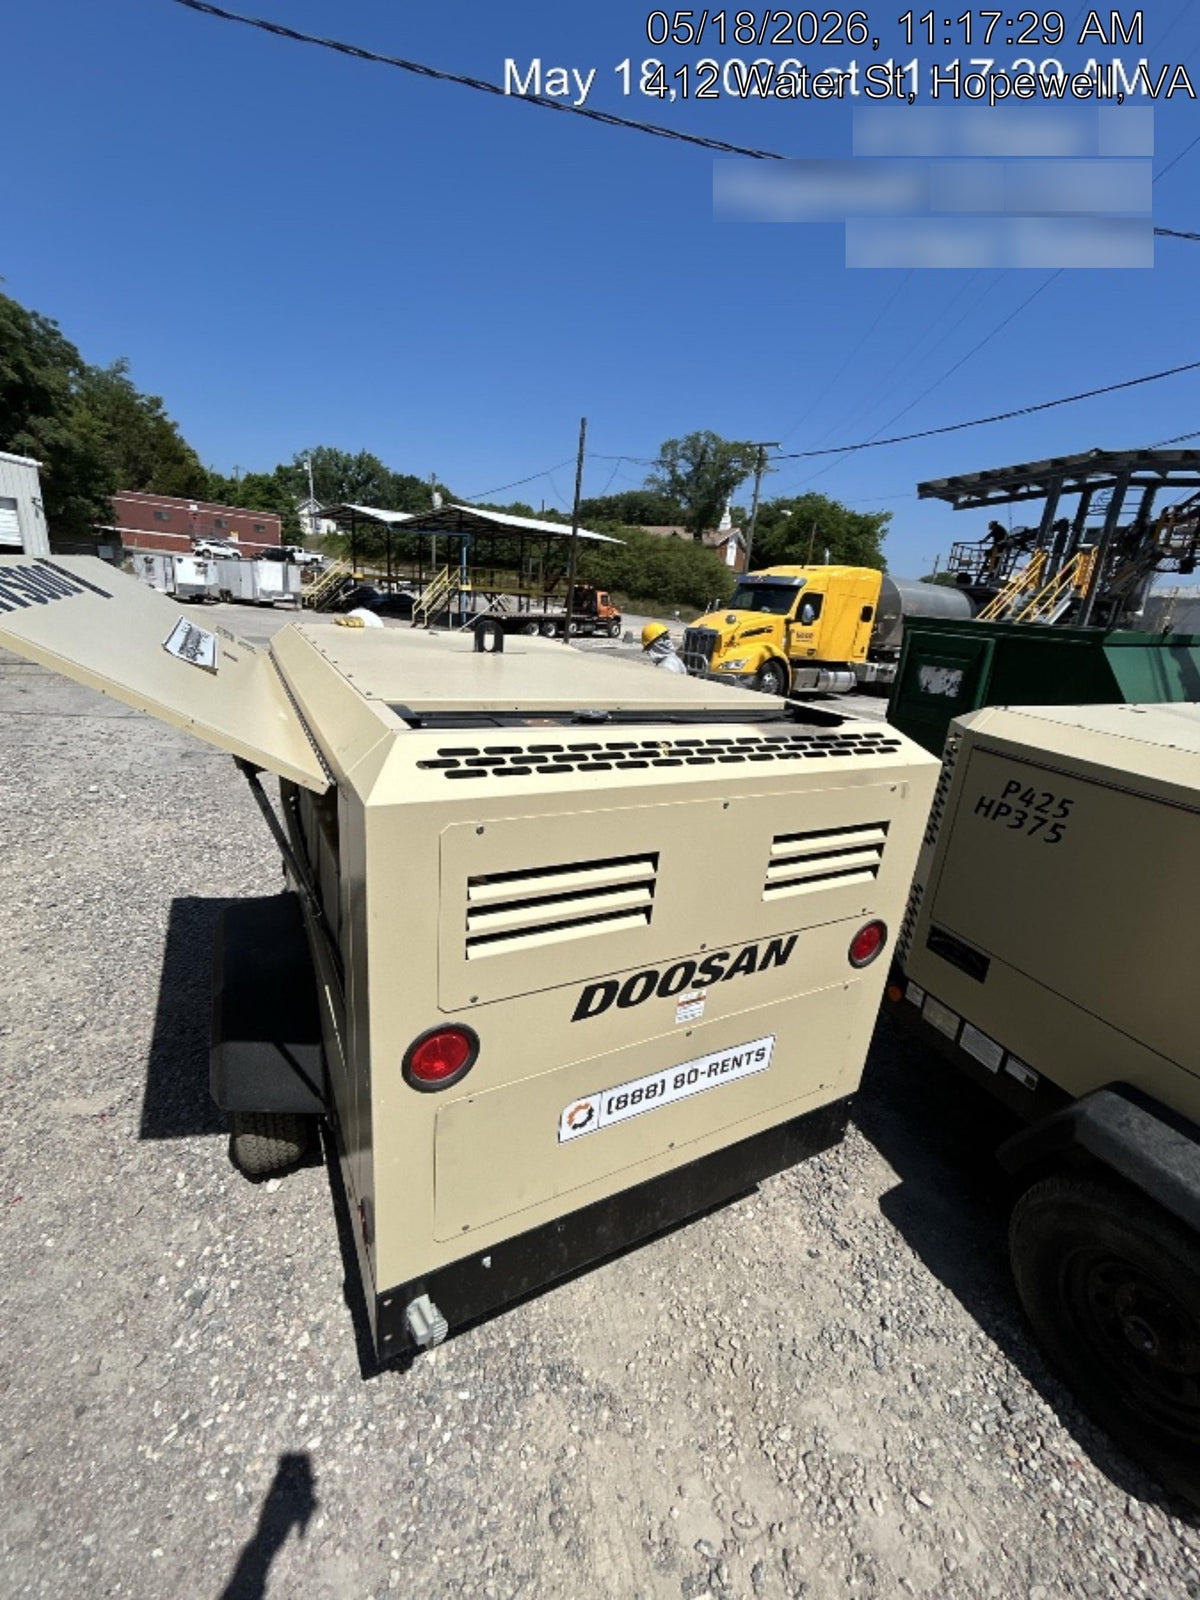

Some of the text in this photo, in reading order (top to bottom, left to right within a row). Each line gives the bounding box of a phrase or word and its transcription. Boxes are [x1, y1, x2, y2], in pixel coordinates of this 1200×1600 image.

[974, 796, 1066, 843] HP375
[1001, 780, 1074, 818] P425
[570, 935, 798, 1022] DOOSAN
[606, 1047, 766, 1115] (888) 80-RENTS
